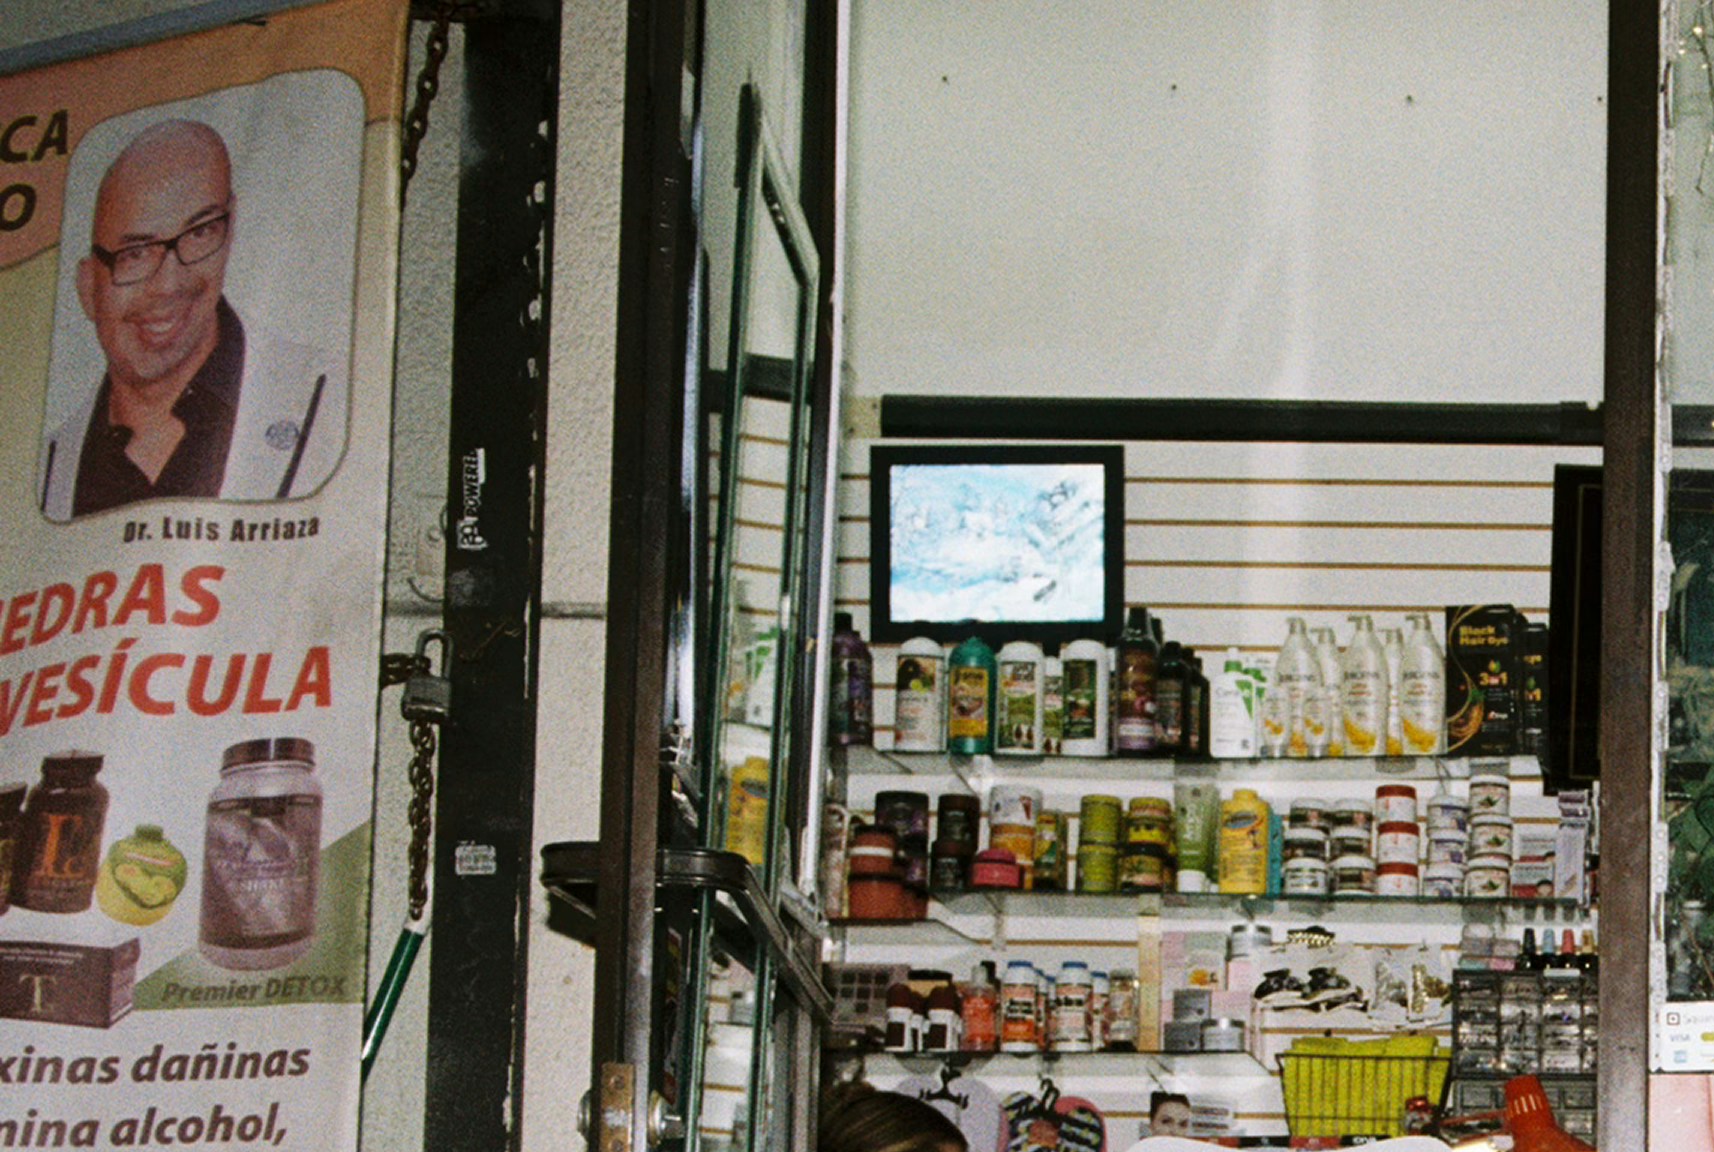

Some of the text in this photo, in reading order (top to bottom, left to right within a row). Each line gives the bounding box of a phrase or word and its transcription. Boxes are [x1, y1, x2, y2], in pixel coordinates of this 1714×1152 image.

[123, 515, 321, 544] Dr. Luis Arriaza
[0, 563, 226, 655] EDRAS
[0, 637, 332, 737] VESÍCULA
[162, 975, 346, 1003] Premier DETOX
[131, 1043, 311, 1083] dañinas
[110, 1102, 287, 1146] alcohol,
